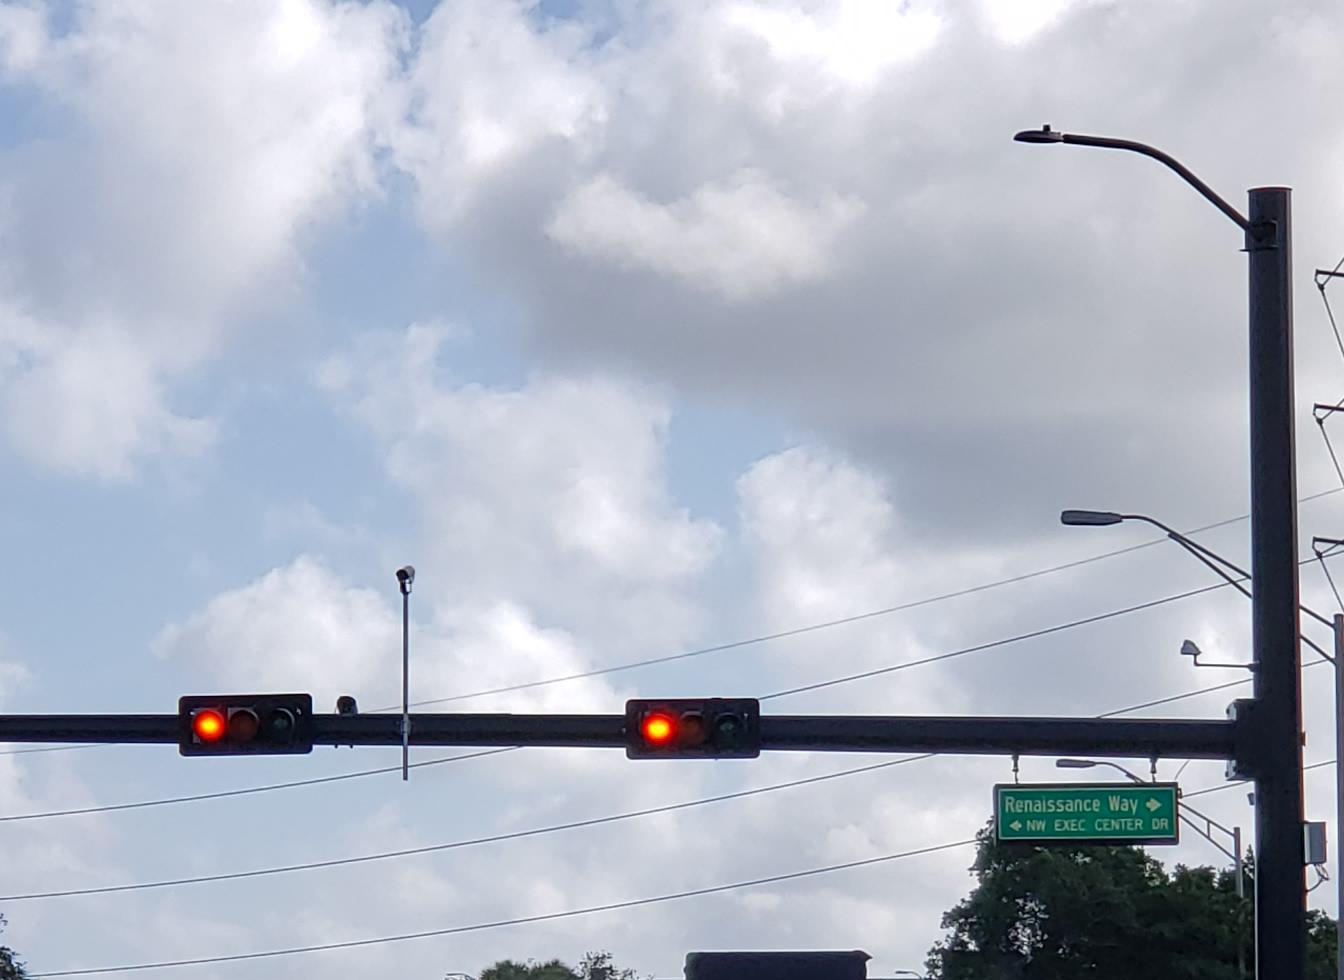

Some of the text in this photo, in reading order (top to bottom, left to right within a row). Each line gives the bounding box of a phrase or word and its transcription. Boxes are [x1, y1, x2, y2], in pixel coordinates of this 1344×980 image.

[1005, 796, 1138, 815] Renaissance Way
[1026, 819, 1169, 832] NW EXEC CENTER DR
